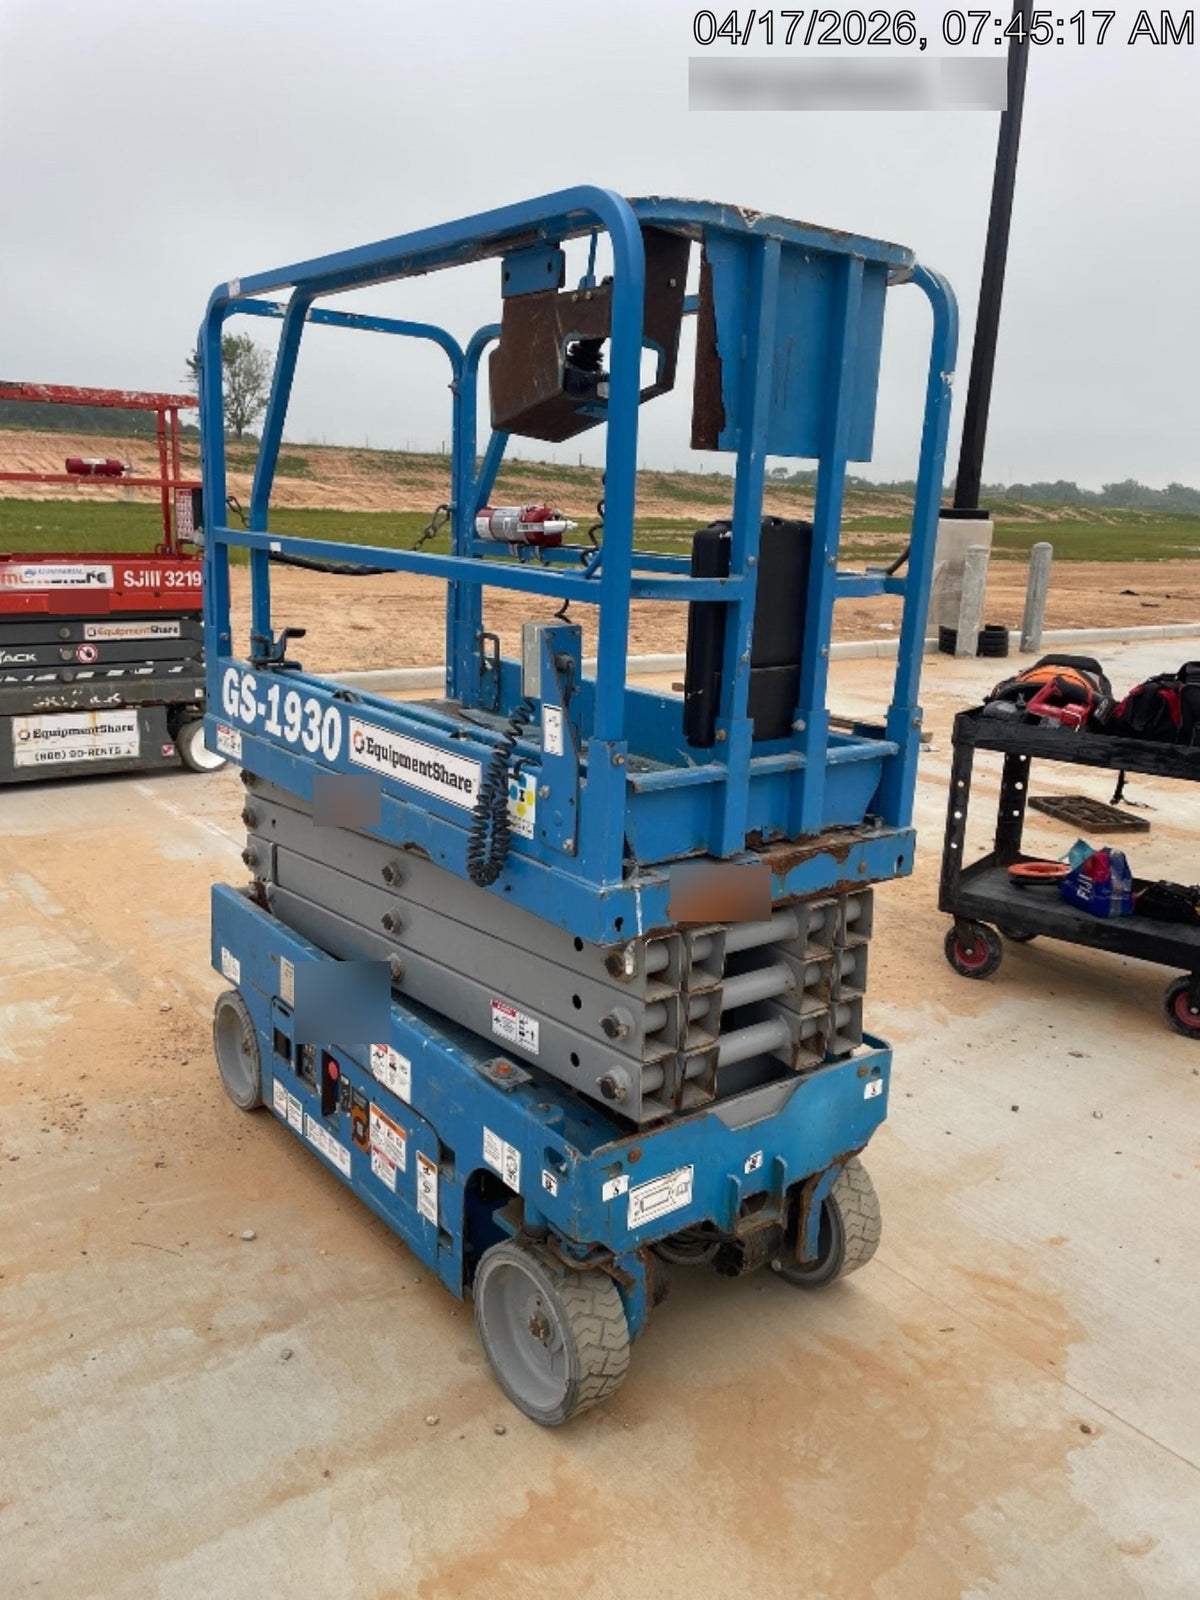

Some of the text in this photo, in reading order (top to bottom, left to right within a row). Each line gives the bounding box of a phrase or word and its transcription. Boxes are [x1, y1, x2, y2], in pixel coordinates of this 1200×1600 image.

[164, 570, 202, 587] 3219
[98, 626, 178, 637] EquipmentShare
[222, 668, 341, 761] GS-1930
[33, 724, 134, 739] EquipmentShare
[366, 737, 473, 793] EquipmentShare
